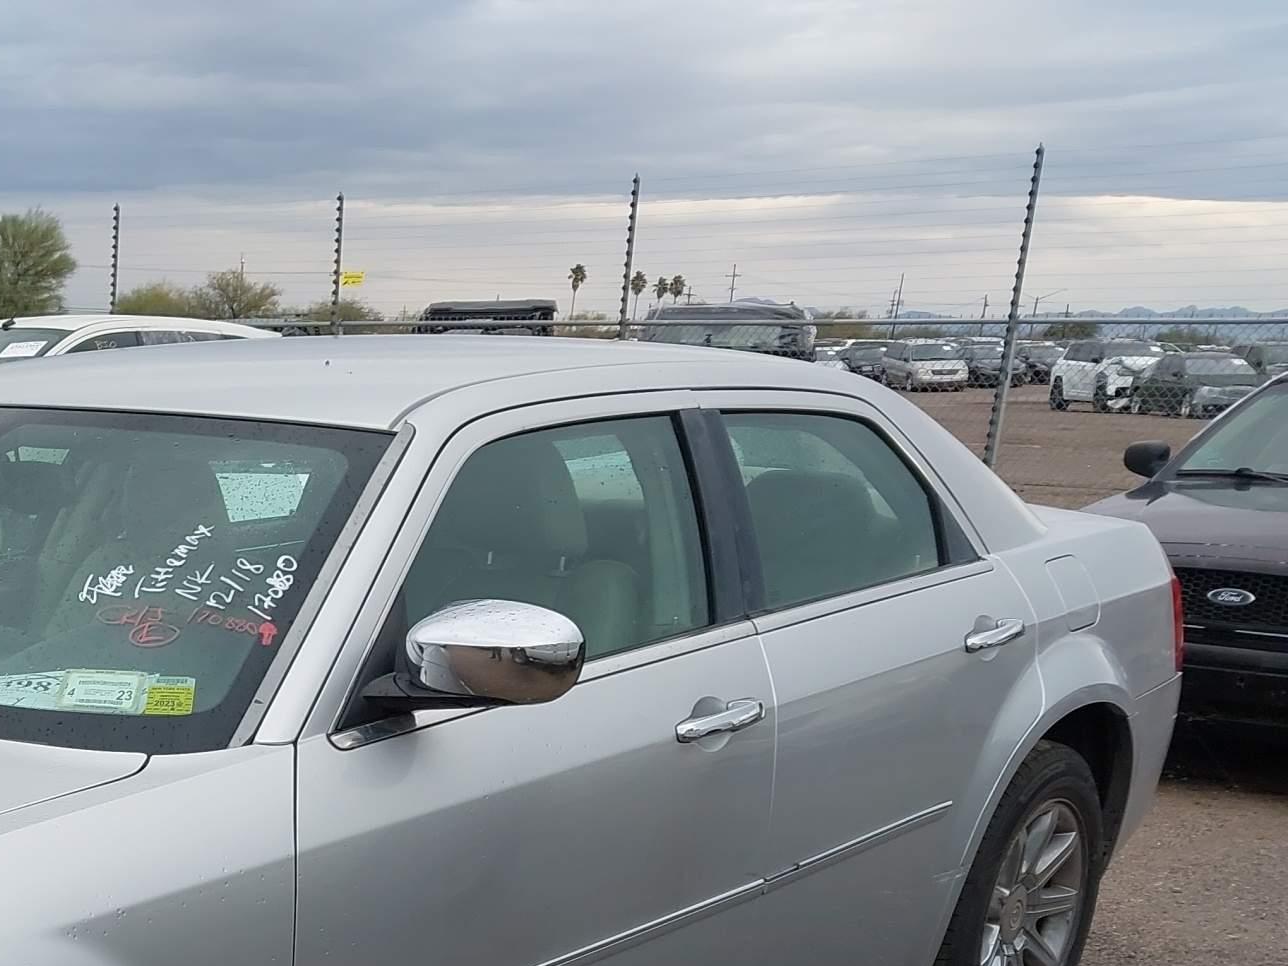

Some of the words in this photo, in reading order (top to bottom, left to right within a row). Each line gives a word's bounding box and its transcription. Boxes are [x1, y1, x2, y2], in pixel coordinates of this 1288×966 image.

[1217, 591, 1244, 602] Ford
[67, 687, 76, 697] 4
[116, 690, 133, 701] 23
[154, 699, 175, 707] 2023
